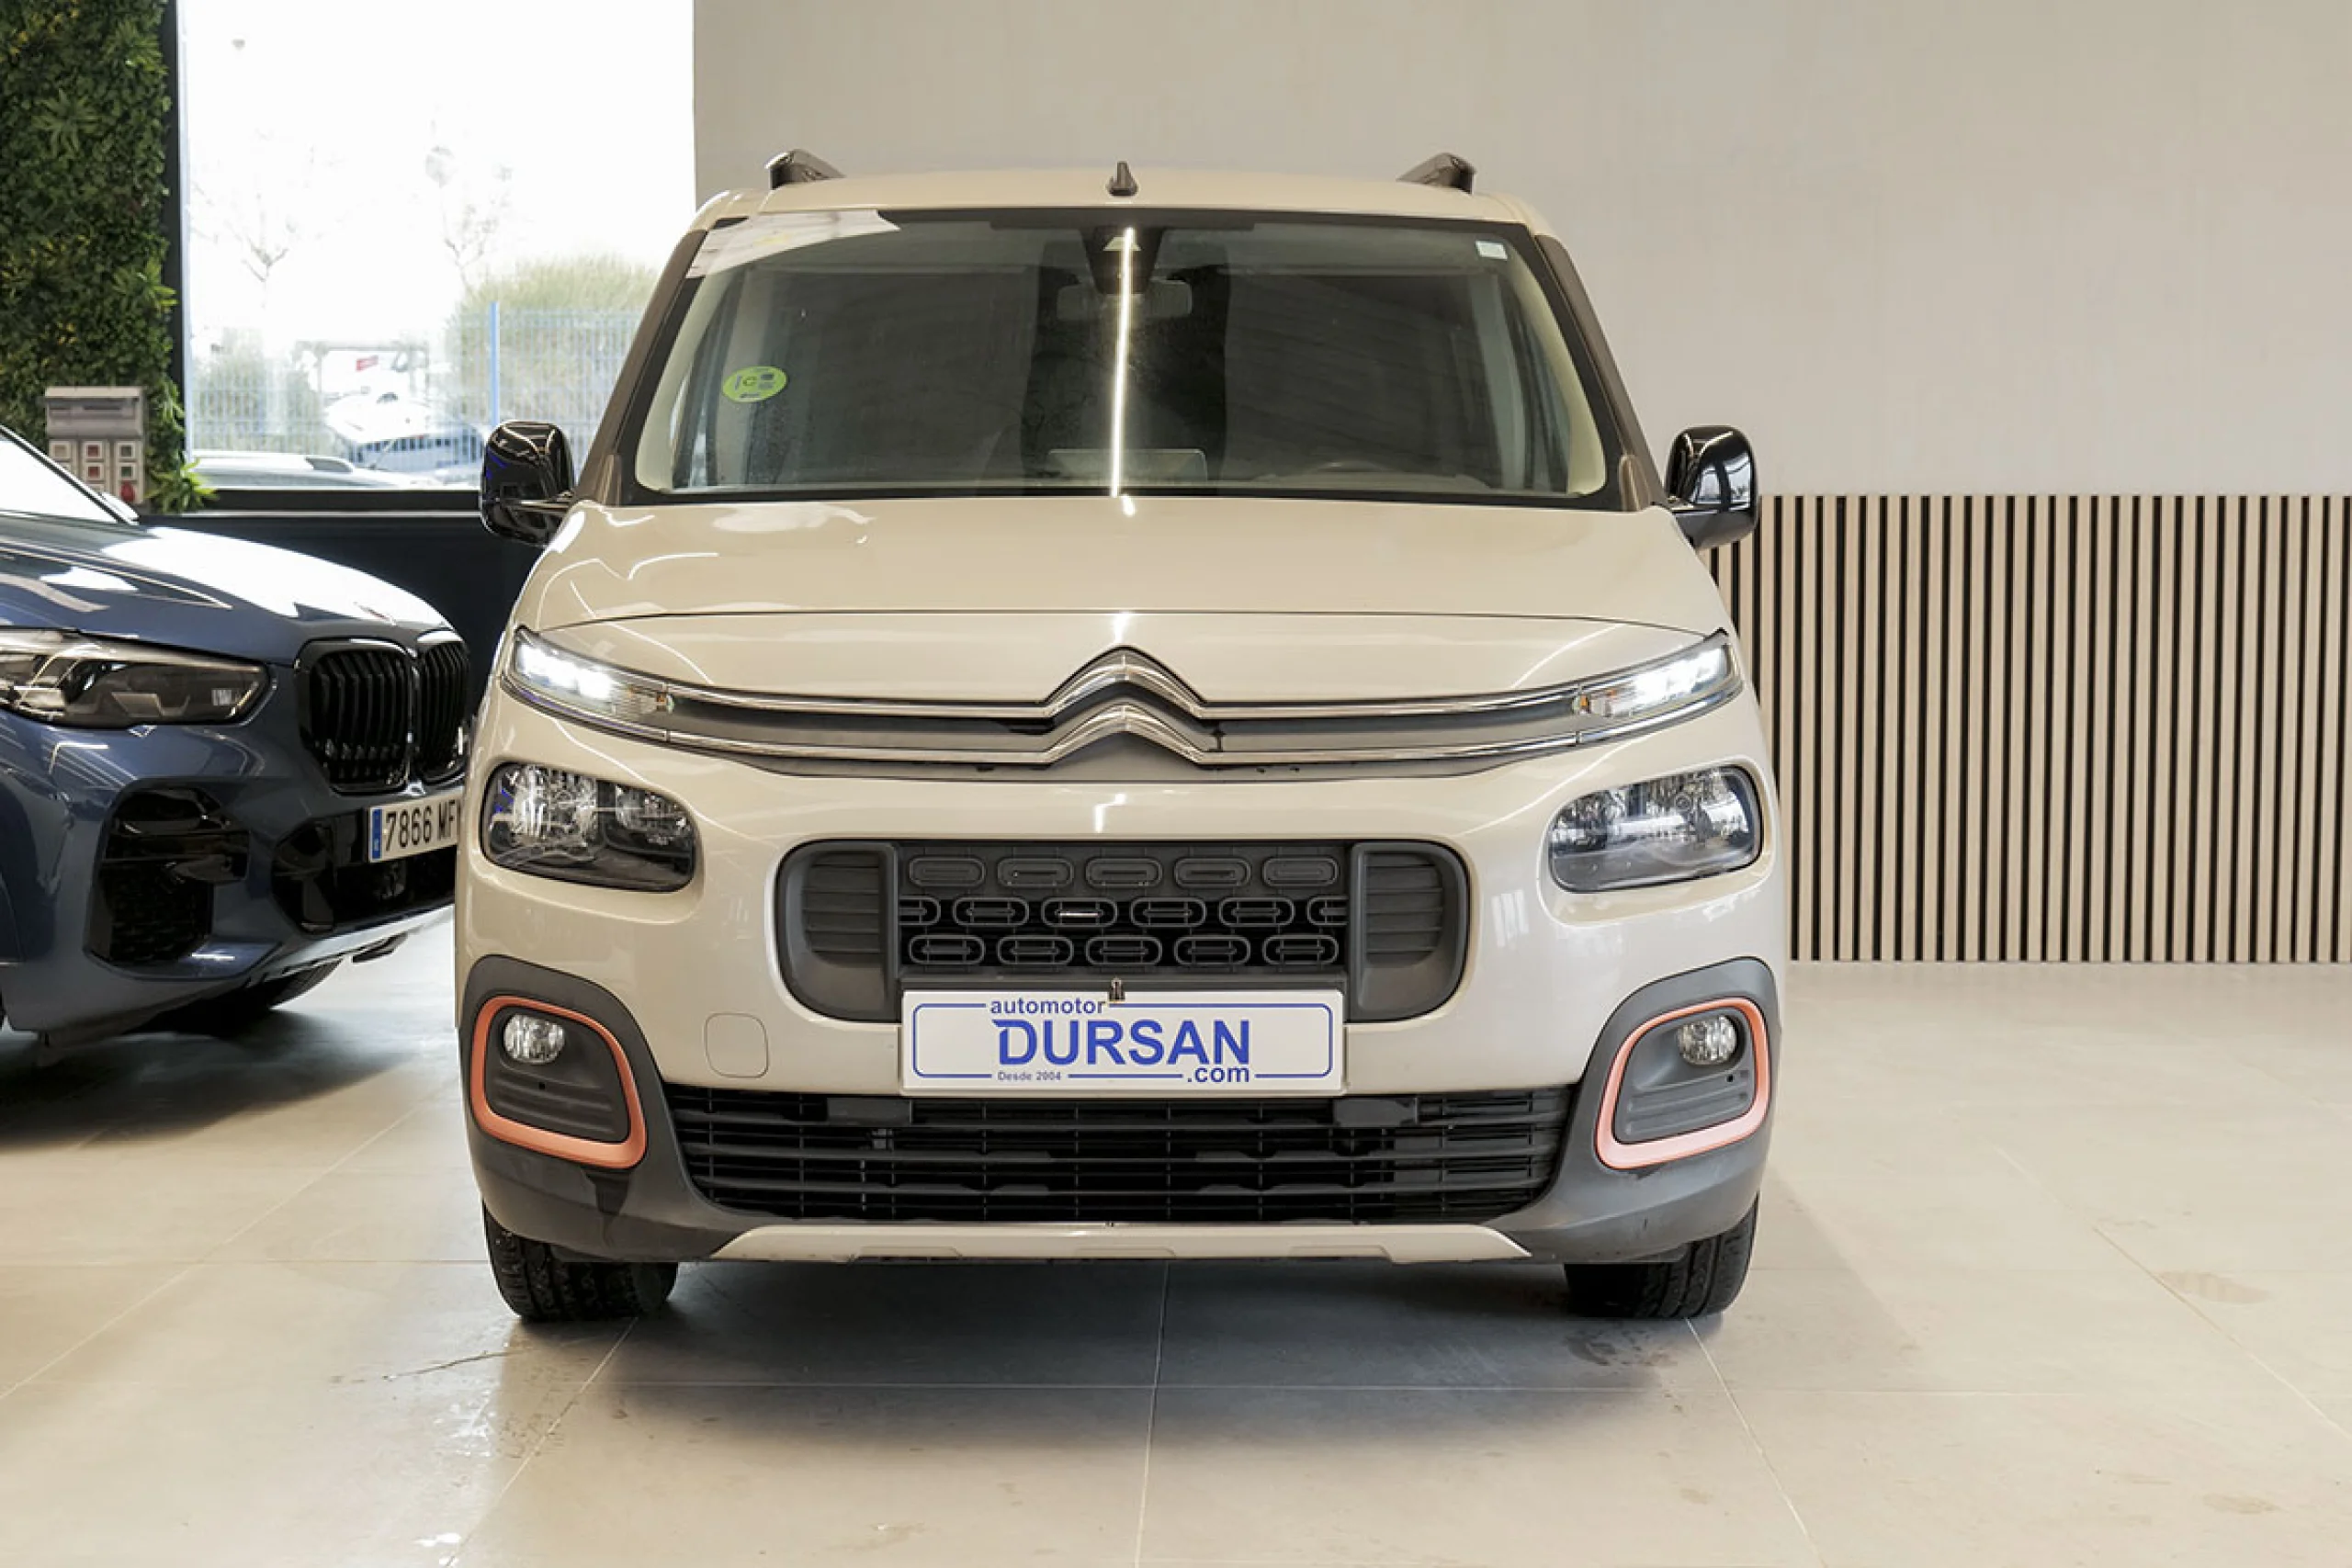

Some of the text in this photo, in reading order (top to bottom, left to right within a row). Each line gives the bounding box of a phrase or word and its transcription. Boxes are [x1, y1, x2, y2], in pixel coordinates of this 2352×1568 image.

[386, 806, 432, 852] 7866
[991, 998, 1105, 1014] automotor
[992, 1019, 1250, 1066] DURSAN
[998, 1071, 1061, 1080] Desde 2004
[1187, 1066, 1250, 1083] .com
